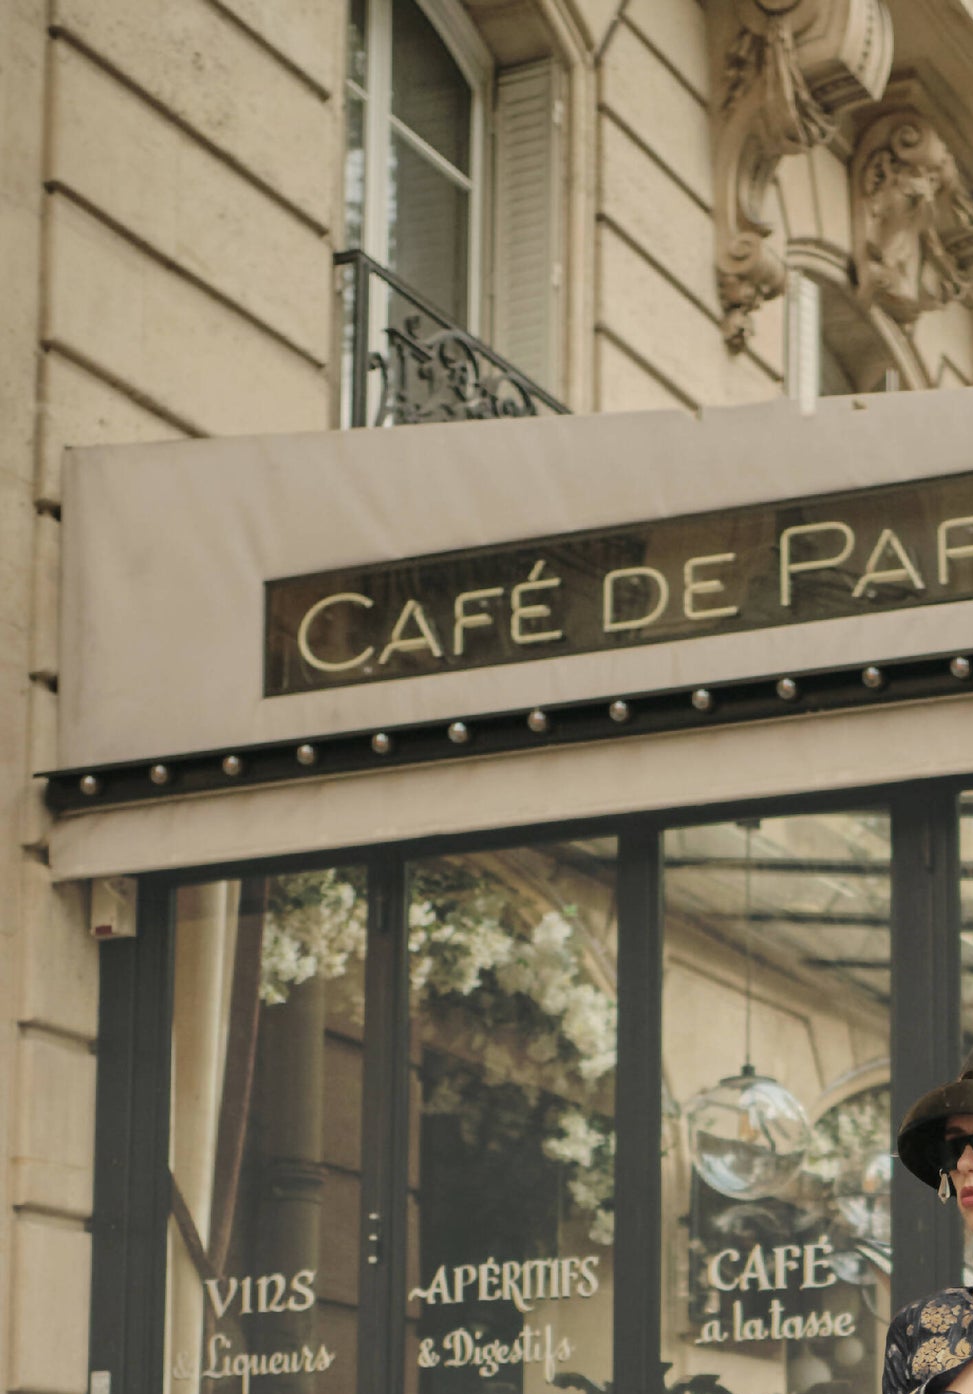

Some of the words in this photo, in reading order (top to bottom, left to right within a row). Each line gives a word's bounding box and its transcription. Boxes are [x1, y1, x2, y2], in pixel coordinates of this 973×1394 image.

[297, 559, 563, 673] CAFÉ
[603, 552, 739, 634] DE
[408, 1257, 599, 1312] APÉRITIFS
[708, 1234, 837, 1291] CAFÉ
[768, 1298, 856, 1341] tasse
[417, 1338, 440, 1368] &
[443, 1326, 575, 1384] Digestifs
